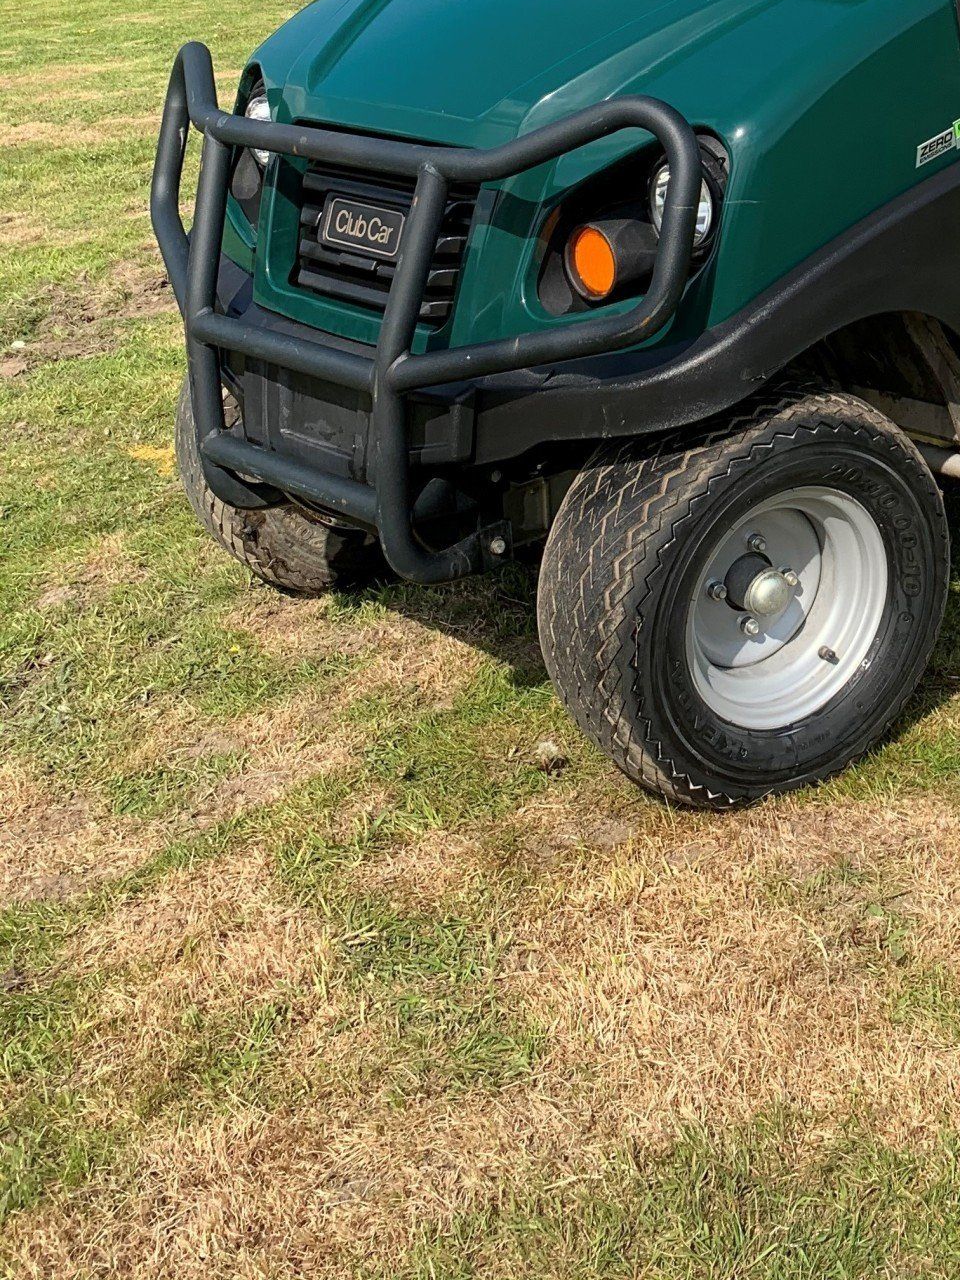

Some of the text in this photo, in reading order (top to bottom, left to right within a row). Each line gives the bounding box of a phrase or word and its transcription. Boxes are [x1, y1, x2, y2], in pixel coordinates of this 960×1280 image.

[920, 131, 953, 158] ZERO
[335, 209, 394, 244] Club Car
